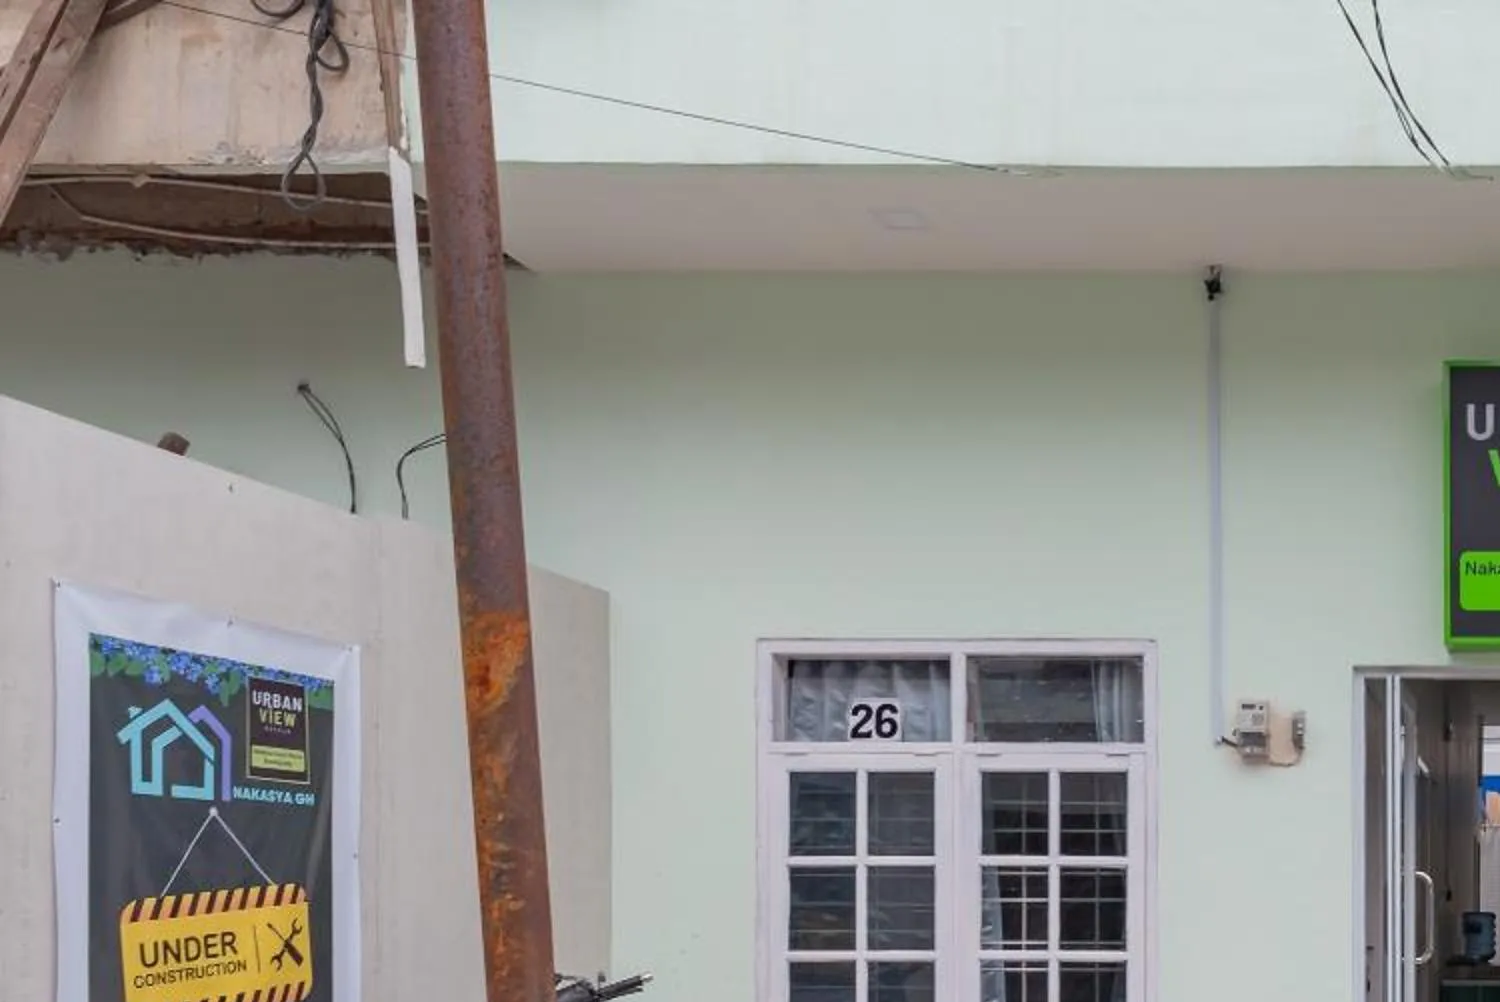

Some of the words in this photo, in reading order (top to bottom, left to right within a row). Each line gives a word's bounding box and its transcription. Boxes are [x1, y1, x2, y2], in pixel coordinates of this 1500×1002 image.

[252, 690, 303, 712] URBAN
[259, 708, 297, 727] VIEW
[851, 704, 898, 738] 26
[233, 786, 293, 804] NAKASYA
[295, 793, 315, 805] GH
[139, 932, 237, 967] UNDER
[133, 960, 247, 989] CONSTRUCTION
